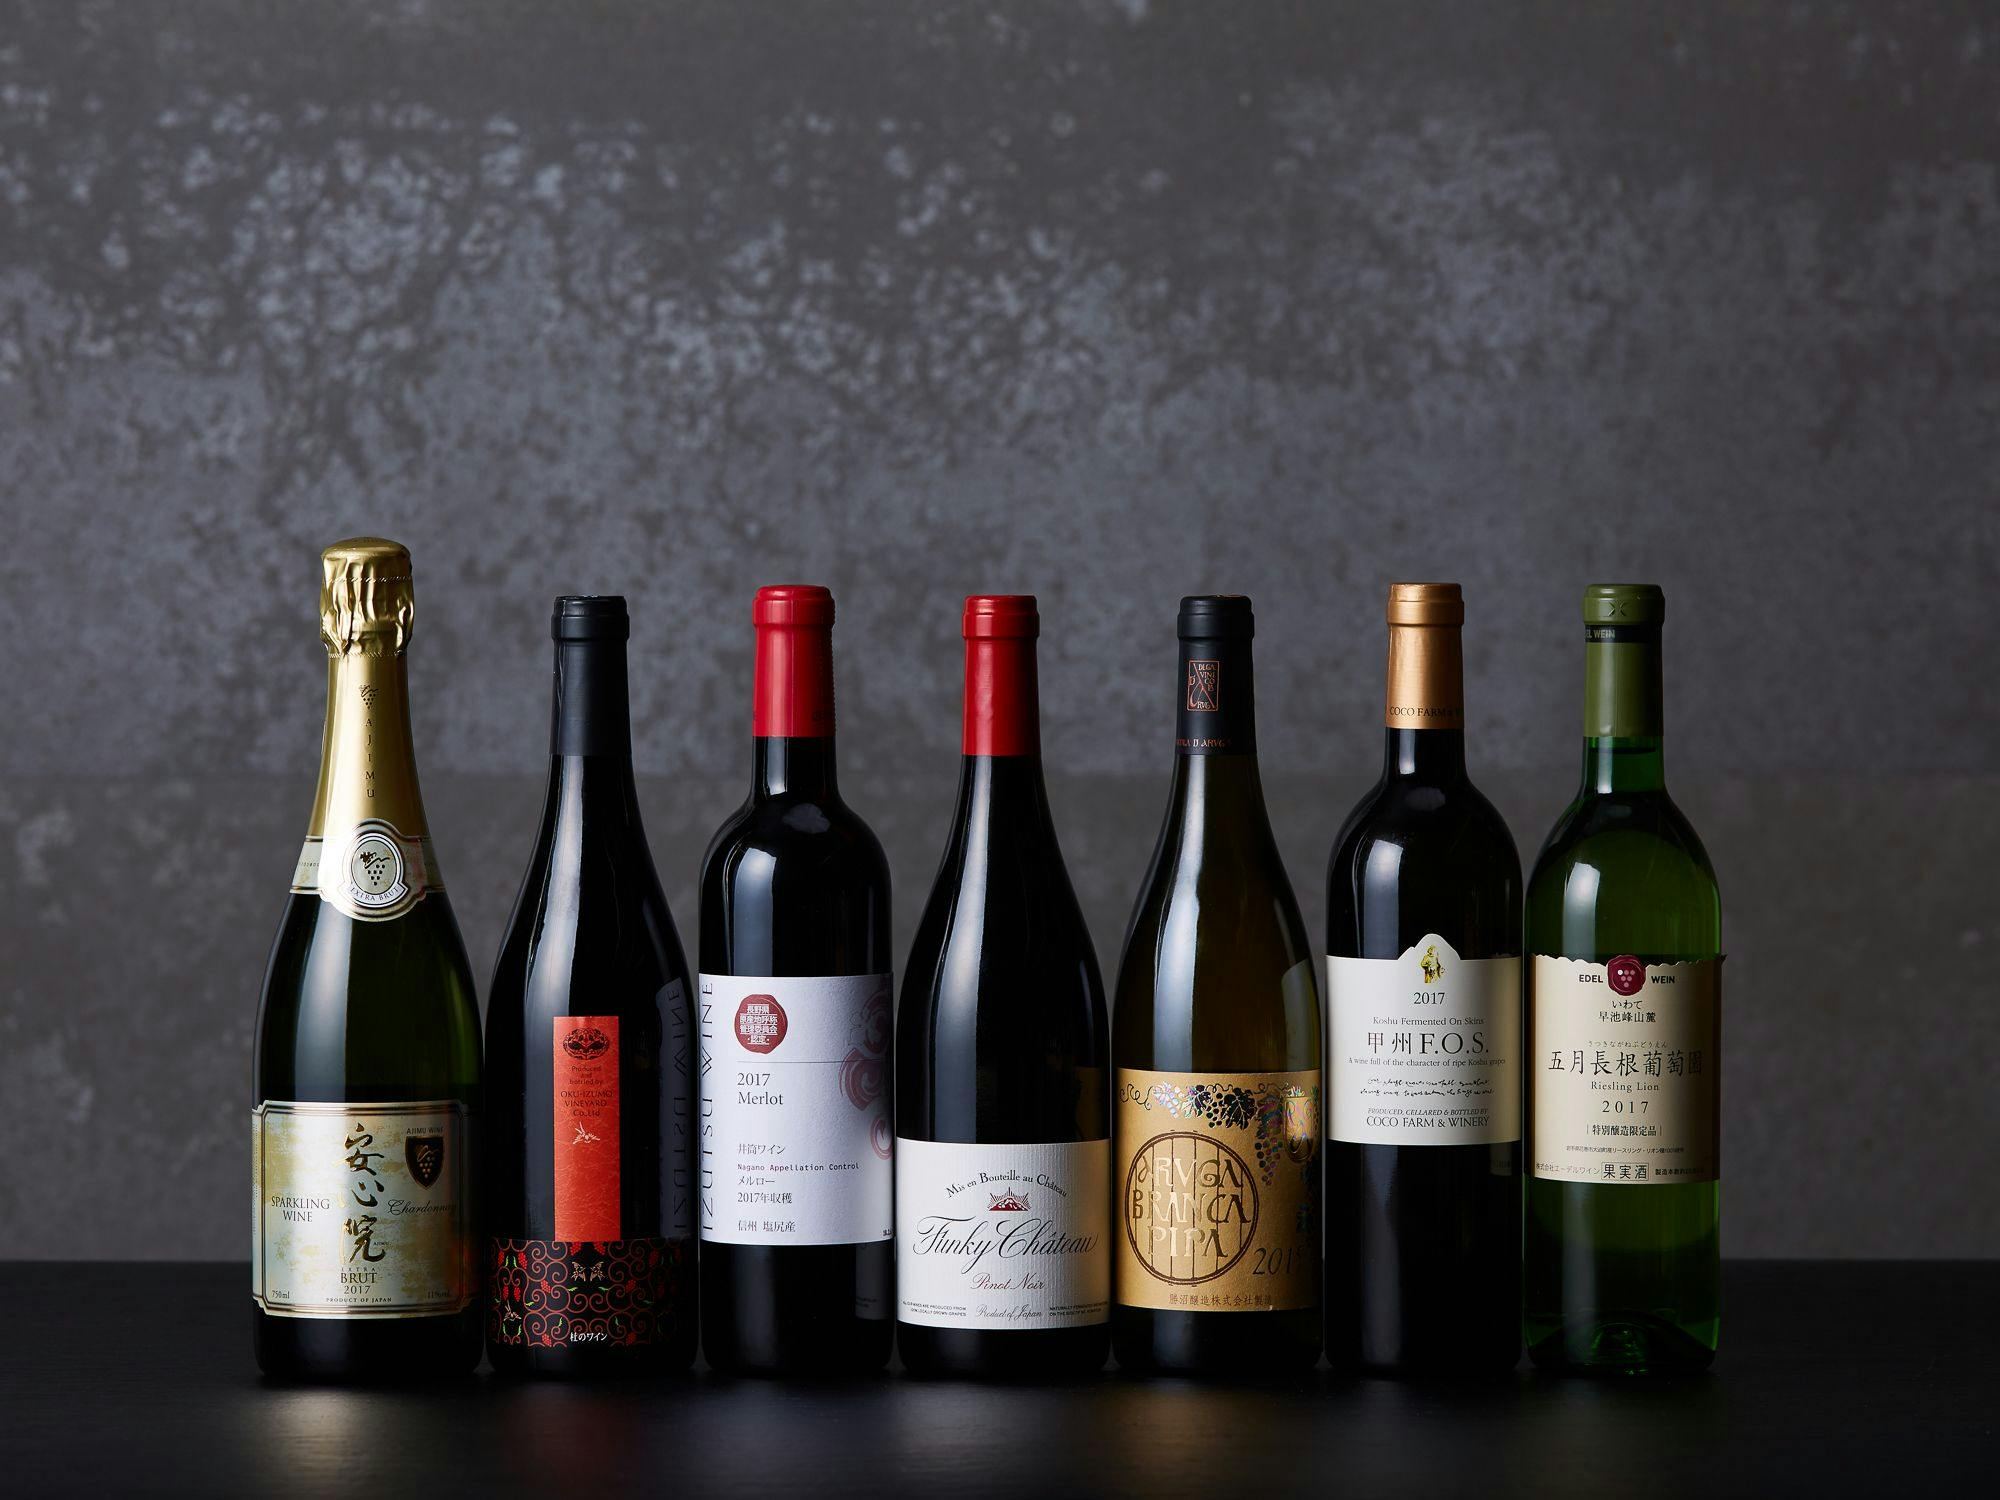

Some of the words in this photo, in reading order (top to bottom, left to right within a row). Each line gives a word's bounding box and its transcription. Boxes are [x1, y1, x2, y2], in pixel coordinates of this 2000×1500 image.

[1593, 629, 1615, 639] WEIN
[1390, 706, 1415, 716] COCO
[366, 718, 374, 798] AJIMU
[379, 888, 399, 901] BRUT
[1579, 974, 1603, 983] EDEL
[1651, 975, 1675, 984] WEIN
[1414, 992, 1445, 1005] 2017
[1612, 1001, 1643, 1010] いわて
[1373, 1017, 1398, 1025] Koshu
[1401, 1017, 1447, 1026] Fermented
[1449, 1017, 1462, 1026] On
[1464, 1016, 1484, 1025] Skins
[1598, 1011, 1656, 1022] 早池峰山麓
[702, 982, 714, 1077] WINE
[1368, 1032, 1412, 1054] 甲州
[1419, 1032, 1489, 1055] F.O.S.
[1587, 1040, 1668, 1049] さつきながねぶどうえん
[1370, 1058, 1381, 1066] full
[1383, 1058, 1391, 1066] of
[1406, 1058, 1440, 1067] character
[1442, 1058, 1450, 1066] of
[1452, 1058, 1466, 1068] ripe
[1468, 1058, 1488, 1066] Koshu
[1548, 1051, 1702, 1077] 五月長根葡萄園
[737, 1072, 771, 1086] 2017
[1591, 1081, 1633, 1093] Riesling
[1637, 1082, 1659, 1091] Lion
[738, 1092, 784, 1105] Merlot
[1367, 1108, 1404, 1116] PRODUCED,
[1602, 1100, 1649, 1114] 2017
[1366, 1117, 1398, 1127] COCO
[1403, 1117, 1434, 1128] FARM
[1437, 1119, 1446, 1128] &
[1449, 1116, 1489, 1127] WINERY
[1592, 1124, 1657, 1136] 特別醸造限定品
[738, 1144, 786, 1154] 井筒ワイン
[702, 1098, 714, 1230] IZUTSU
[770, 1163, 824, 1172] Appellation
[829, 1162, 860, 1170] Control
[1536, 1163, 1600, 1175] 株式会社エーデルワイン
[1603, 1164, 1648, 1180] 果実酒
[738, 1176, 775, 1186] メルロー
[946, 1182, 965, 1198] Mis
[967, 1180, 977, 1188] en
[980, 1170, 1020, 1184] Bouteille
[1022, 1175, 1033, 1183] au
[1036, 1173, 1068, 1198] Château
[271, 1196, 330, 1210] SPARKLING
[737, 1192, 792, 1204] 2017年収穫
[388, 1199, 456, 1216] Chardonna
[1132, 1189, 1252, 1224] BRANCA
[282, 1210, 312, 1222] WINE
[738, 1220, 757, 1231] 信州
[763, 1220, 796, 1232] 塩尻産
[912, 1216, 1001, 1274] Funky
[996, 1218, 1099, 1259] Château
[1147, 1226, 1228, 1258] PIPA
[340, 1272, 377, 1284] BRUT
[970, 1272, 1012, 1290] Pinot
[1010, 1272, 1045, 1290] Noir
[344, 1286, 370, 1294] 2017
[1169, 1294, 1272, 1306] 勝沼醸造株式会社製造
[976, 1304, 1007, 1317] Product
[1014, 1304, 1042, 1321] Japan
[570, 1332, 608, 1342] 杜のワイン
